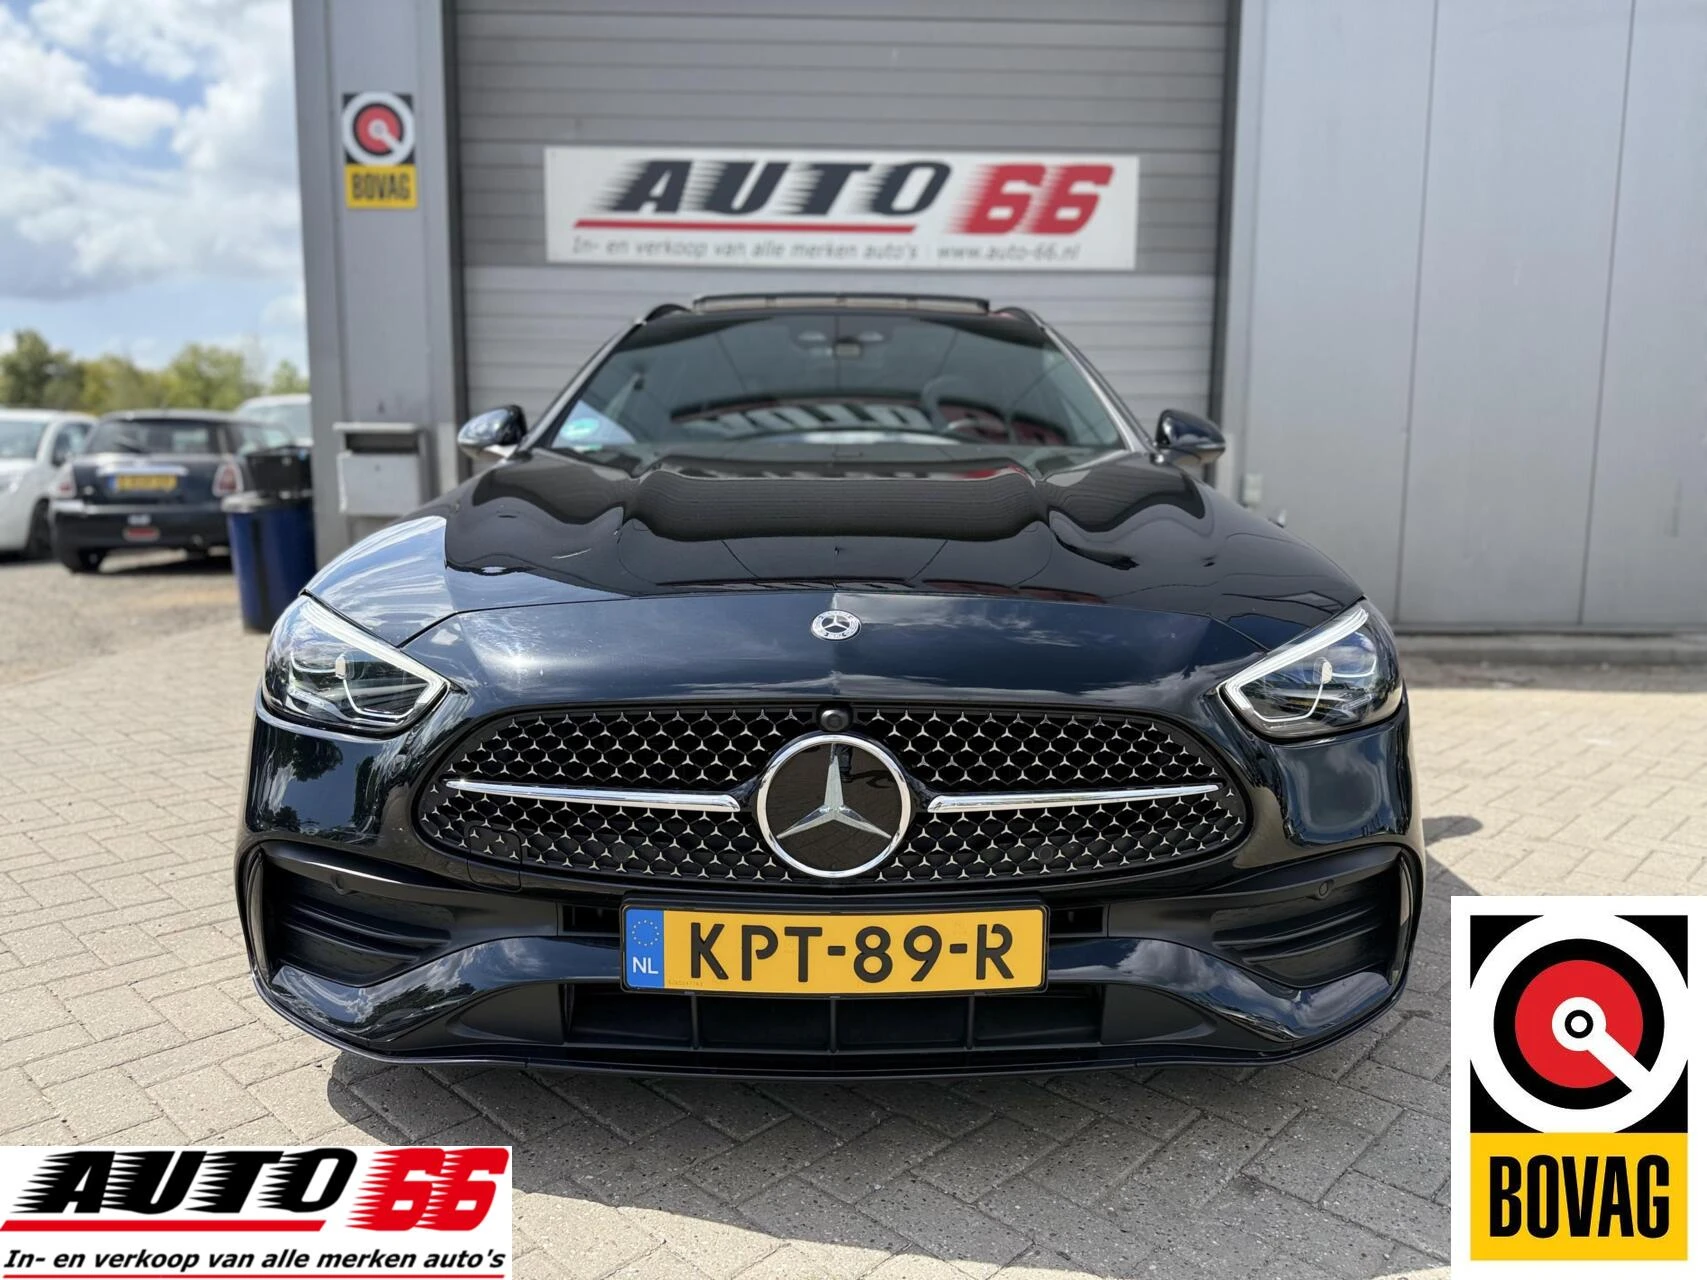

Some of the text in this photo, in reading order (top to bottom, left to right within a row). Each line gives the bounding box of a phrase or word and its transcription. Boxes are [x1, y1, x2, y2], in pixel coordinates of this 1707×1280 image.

[351, 173, 411, 201] BOVAG
[598, 159, 1114, 235] AUTO 66
[573, 236, 1081, 261] In- en verkoop van alle merken auto's www.auto-66.nl
[632, 956, 659, 975] NL
[690, 921, 1015, 983] KPT-89-R
